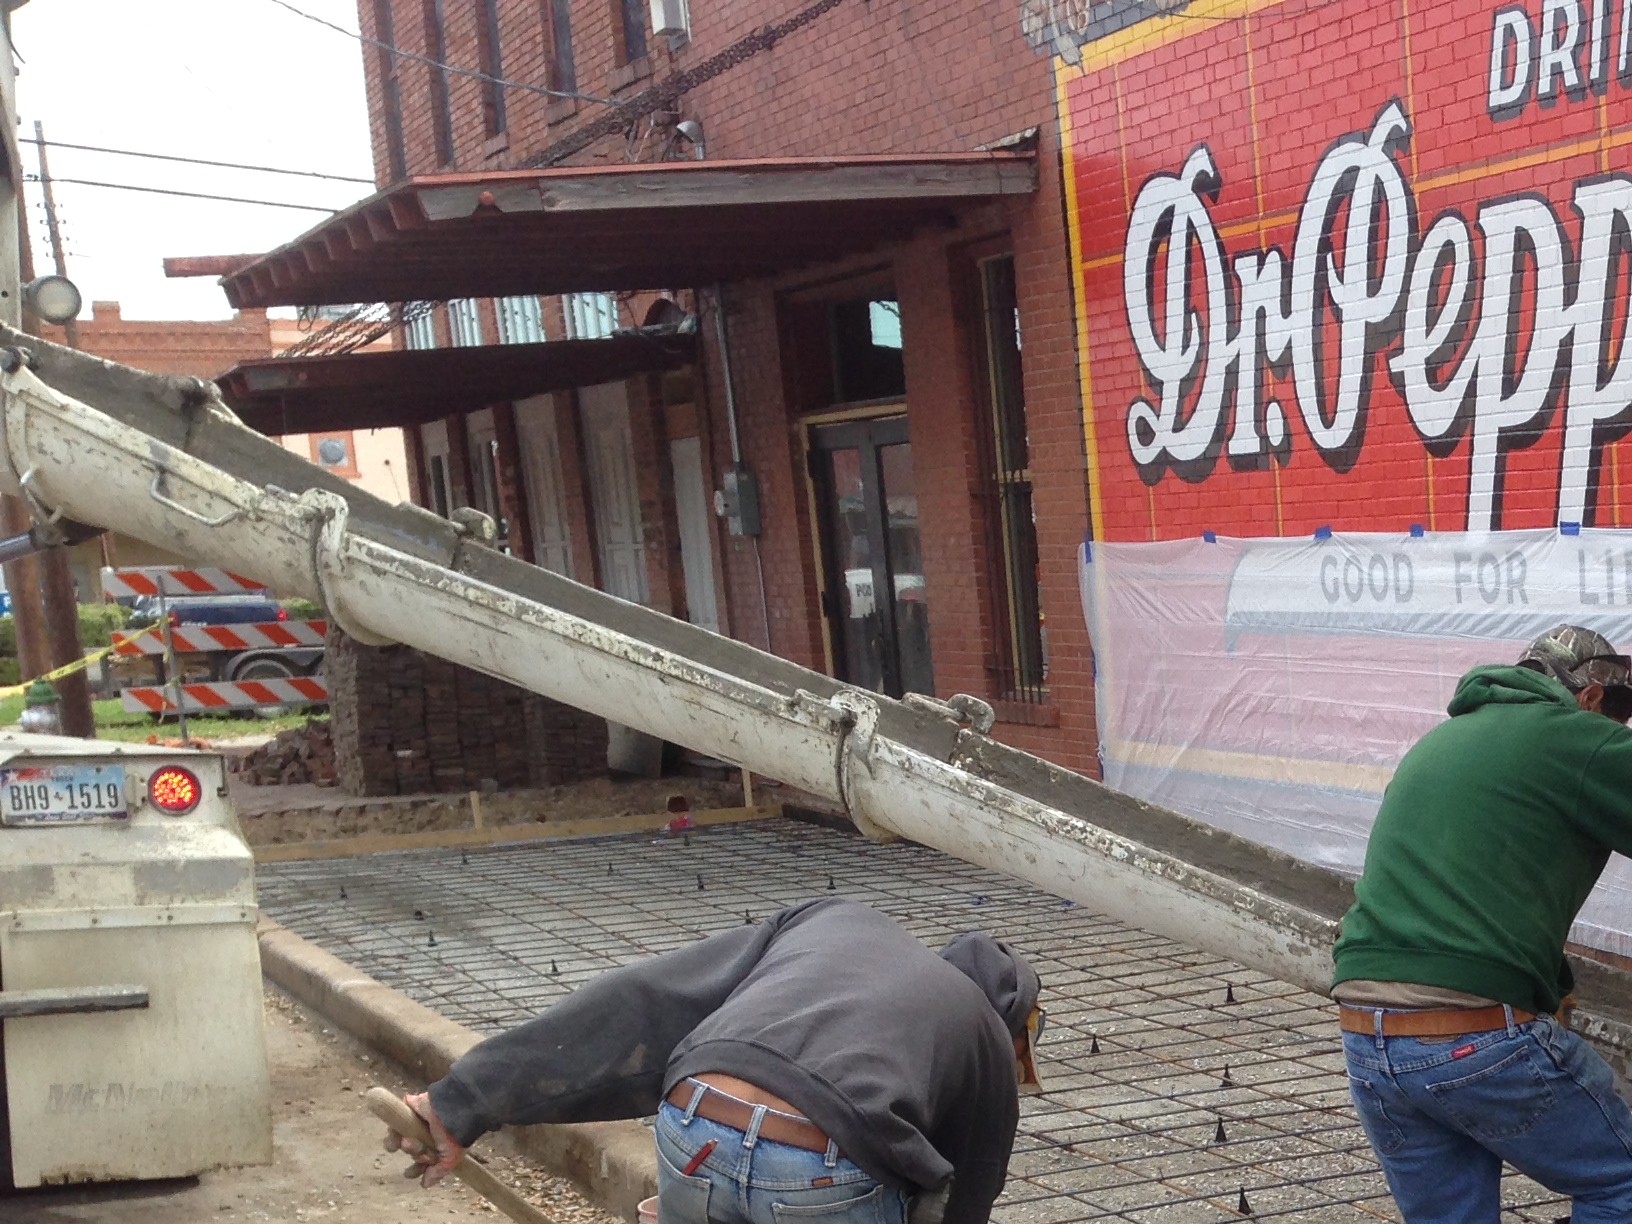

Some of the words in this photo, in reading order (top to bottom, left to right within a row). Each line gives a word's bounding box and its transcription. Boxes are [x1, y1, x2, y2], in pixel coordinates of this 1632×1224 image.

[1318, 552, 1415, 604] GOOD
[1453, 549, 1530, 605] FOR
[9, 784, 50, 811] BH9
[65, 782, 119, 810] 1519
